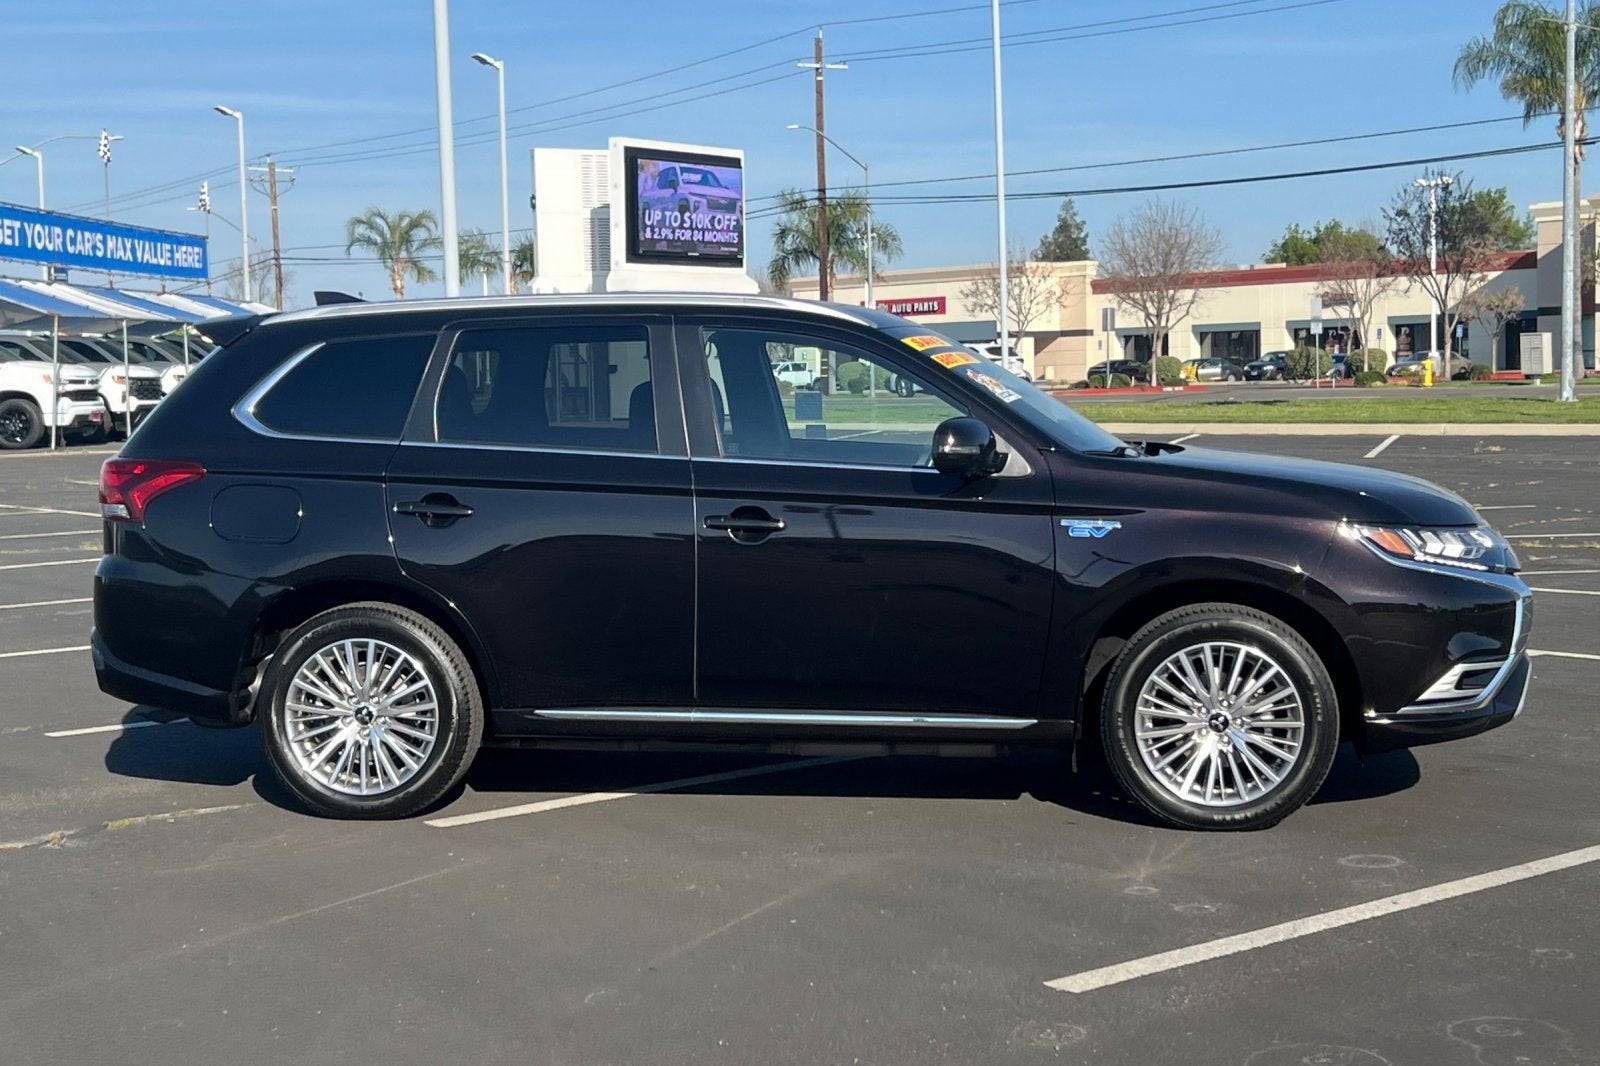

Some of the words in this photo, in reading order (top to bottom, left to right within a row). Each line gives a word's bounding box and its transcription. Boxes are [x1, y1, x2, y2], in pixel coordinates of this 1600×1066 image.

[644, 209, 662, 226] UP
[665, 211, 681, 227] TO
[683, 211, 712, 229] $10K
[714, 214, 737, 230] OFF
[645, 227, 652, 239] &
[653, 228, 673, 240] 2.9%
[674, 229, 691, 241] FOR
[23, 221, 63, 252] YOUR
[66, 228, 104, 258] CAR'S
[106, 234, 134, 262] MAX
[134, 239, 172, 268] VALUE
[173, 244, 203, 269] HERE!
[891, 303, 912, 314] AUTO
[913, 301, 939, 312] PARTS
[1068, 526, 1113, 538] EV
